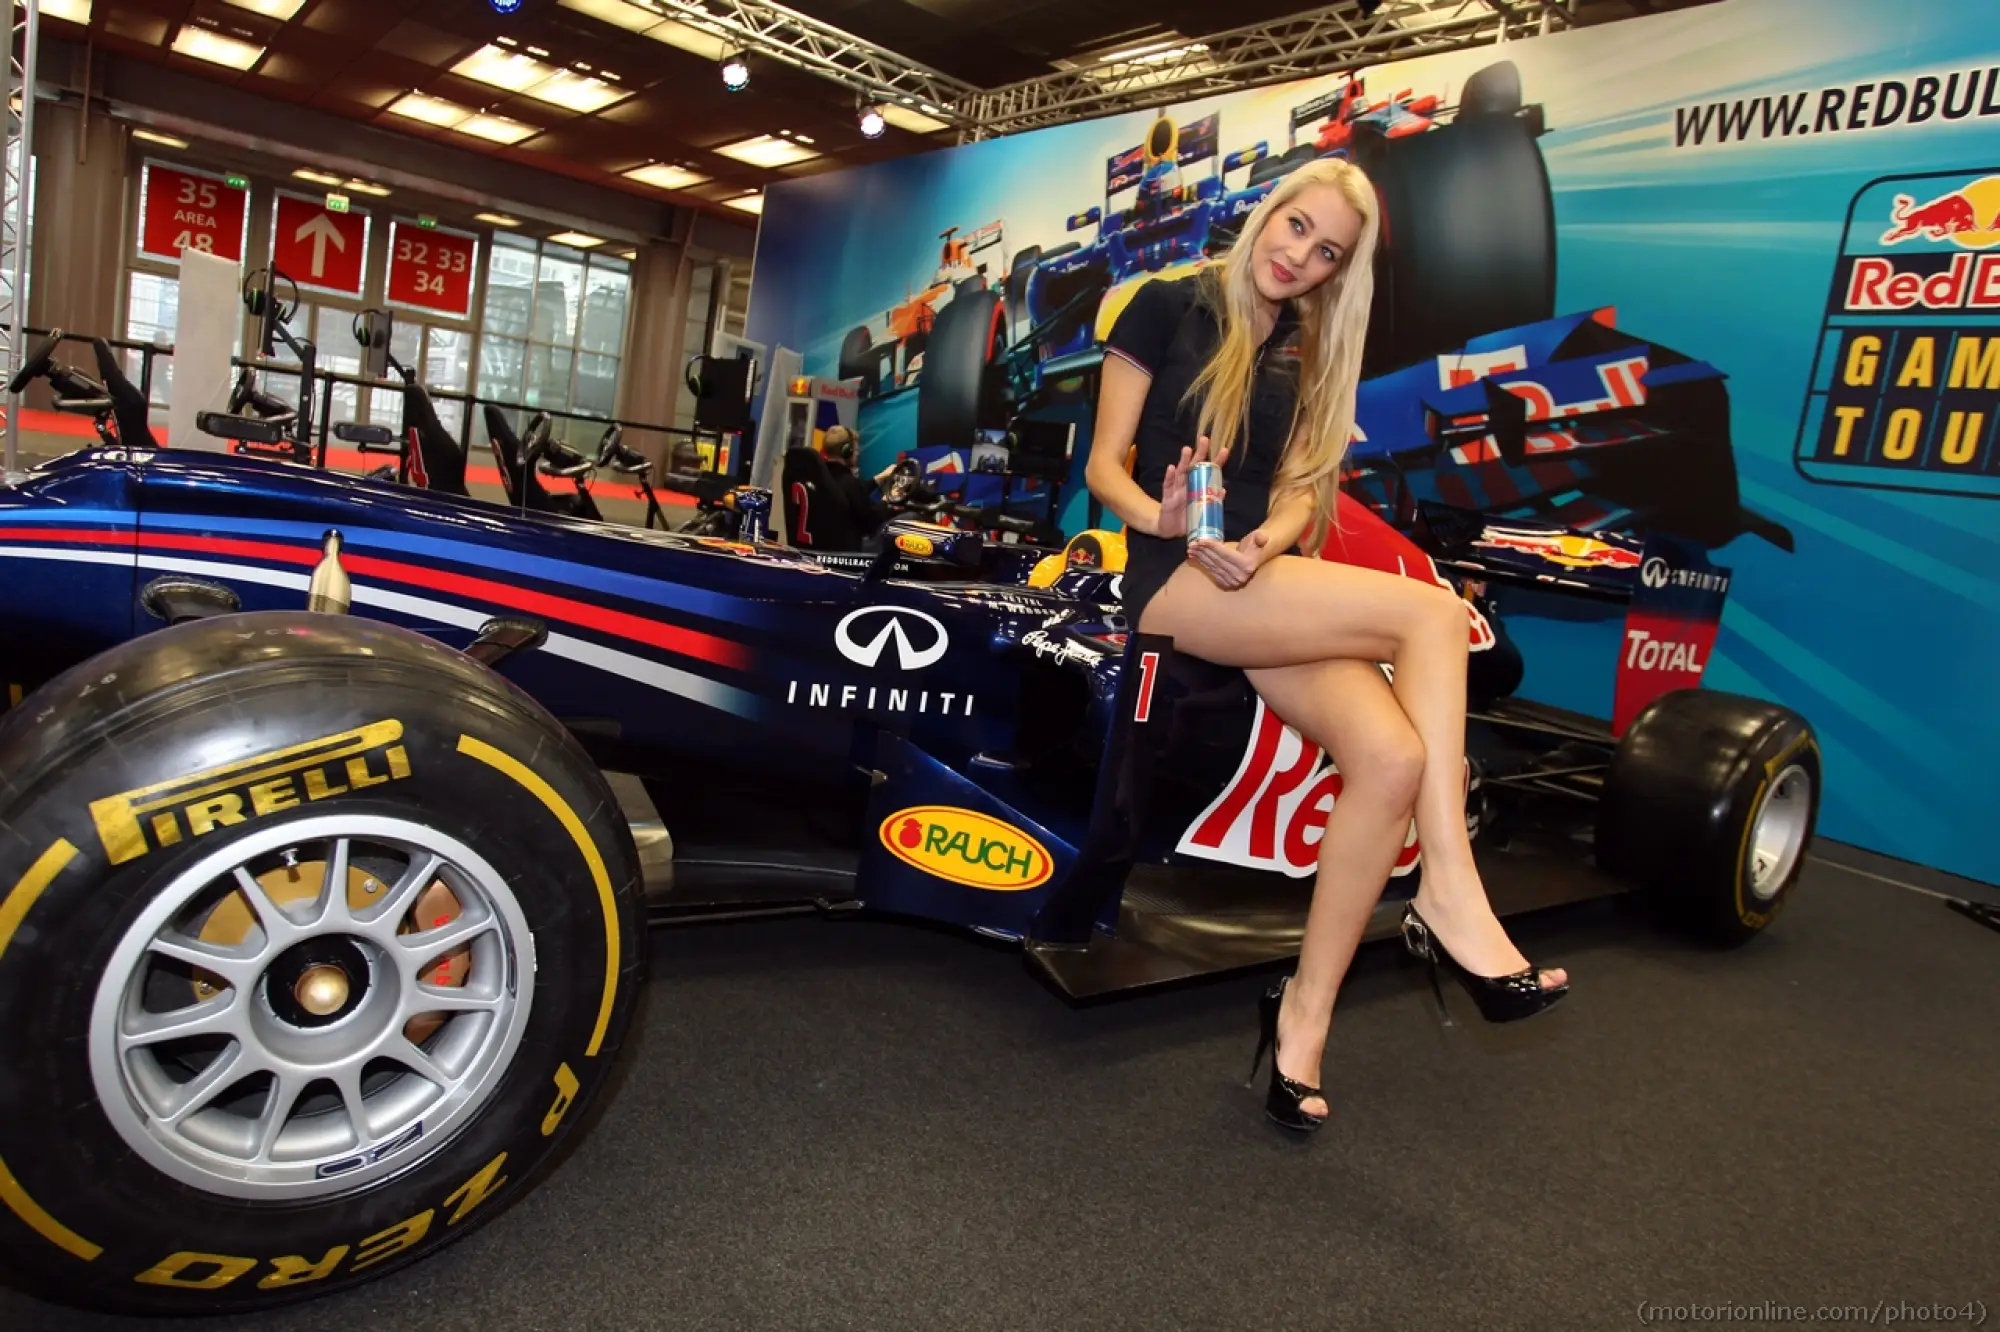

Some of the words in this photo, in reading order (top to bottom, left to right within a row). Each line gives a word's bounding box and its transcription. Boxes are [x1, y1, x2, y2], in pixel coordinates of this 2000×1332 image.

[1676, 69, 2000, 147] WWW.REDBUL
[177, 178, 217, 209] 35
[172, 230, 214, 255] 48
[174, 209, 217, 229] AREA
[398, 239, 428, 265] 32
[436, 248, 466, 273] 33
[414, 270, 444, 295] 34
[1847, 254, 1973, 309] Red
[1627, 630, 1703, 673] TOTAL
[787, 680, 974, 716] INFINITI
[1134, 651, 1160, 722] 1
[89, 718, 412, 865] PIRELLI
[925, 823, 1033, 879] RAUCH
[541, 1061, 580, 1137] P
[134, 1151, 508, 1289] ZERO
